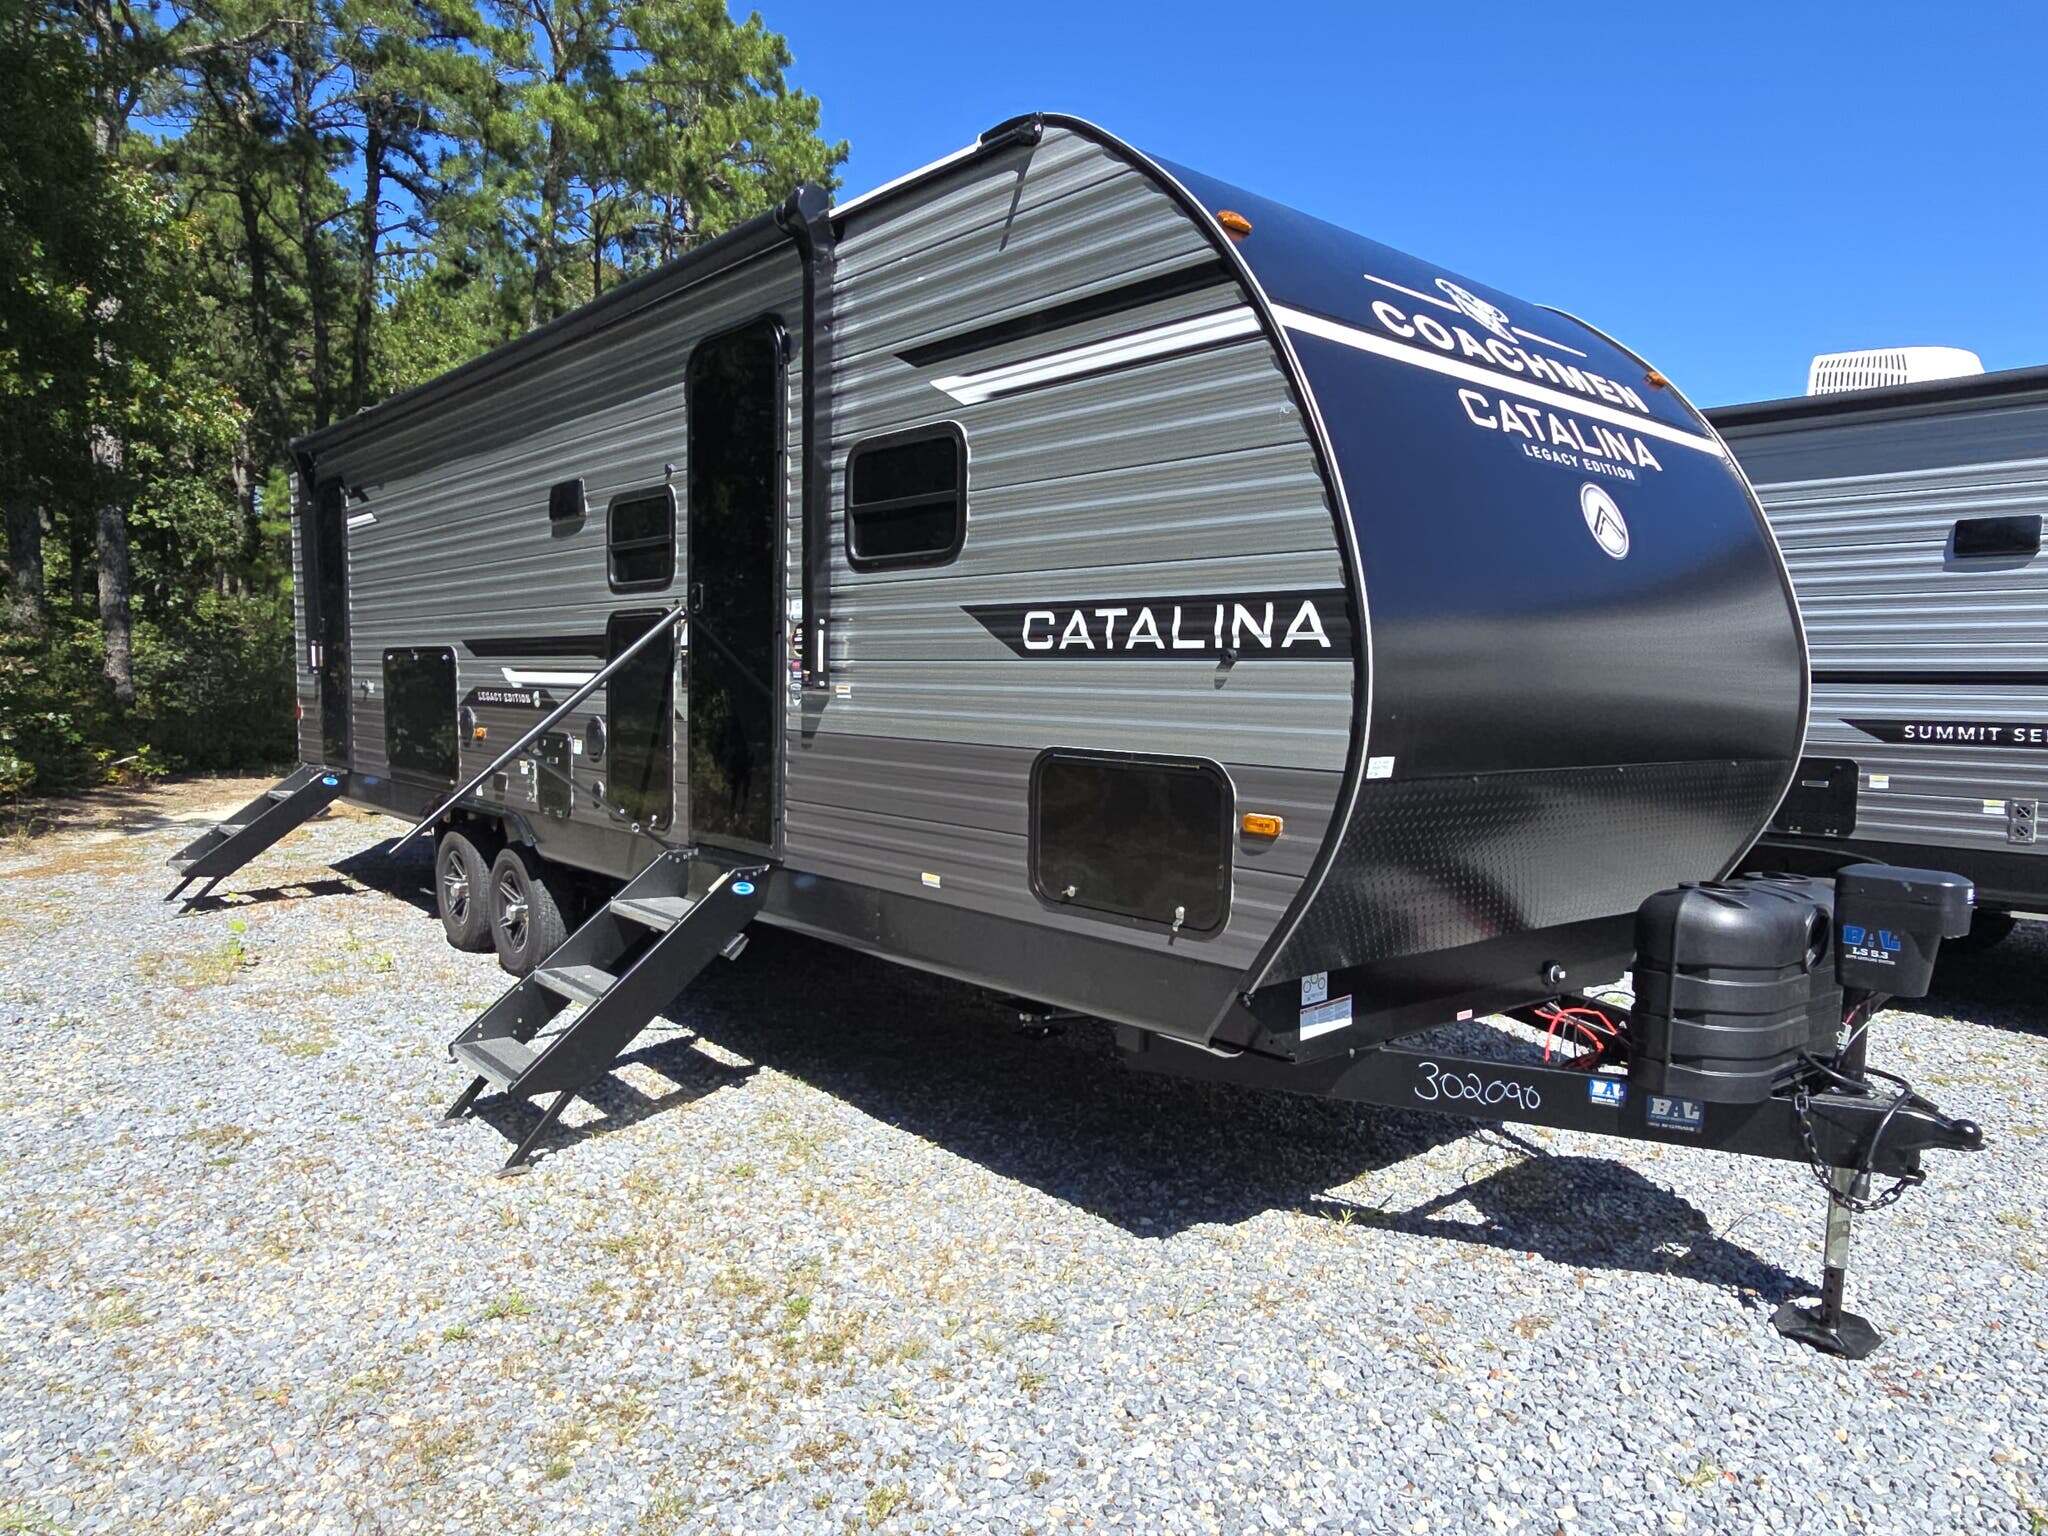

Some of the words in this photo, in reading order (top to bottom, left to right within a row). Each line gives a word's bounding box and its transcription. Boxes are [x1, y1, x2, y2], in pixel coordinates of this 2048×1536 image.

[1371, 299, 1650, 414] COACHMEN
[1457, 388, 1664, 472] CATALINA
[1522, 442, 1579, 468] LEGACY
[1582, 457, 1636, 481] EDITION
[1022, 599, 1332, 651] CATALINA
[477, 690, 502, 702] LEGACY
[503, 692, 531, 704] EDITION
[1904, 724, 2002, 741] SUMMIT
[2013, 728, 2048, 743] SE
[1414, 1061, 1541, 1110] 302090
[1651, 1096, 1701, 1121] BAL
